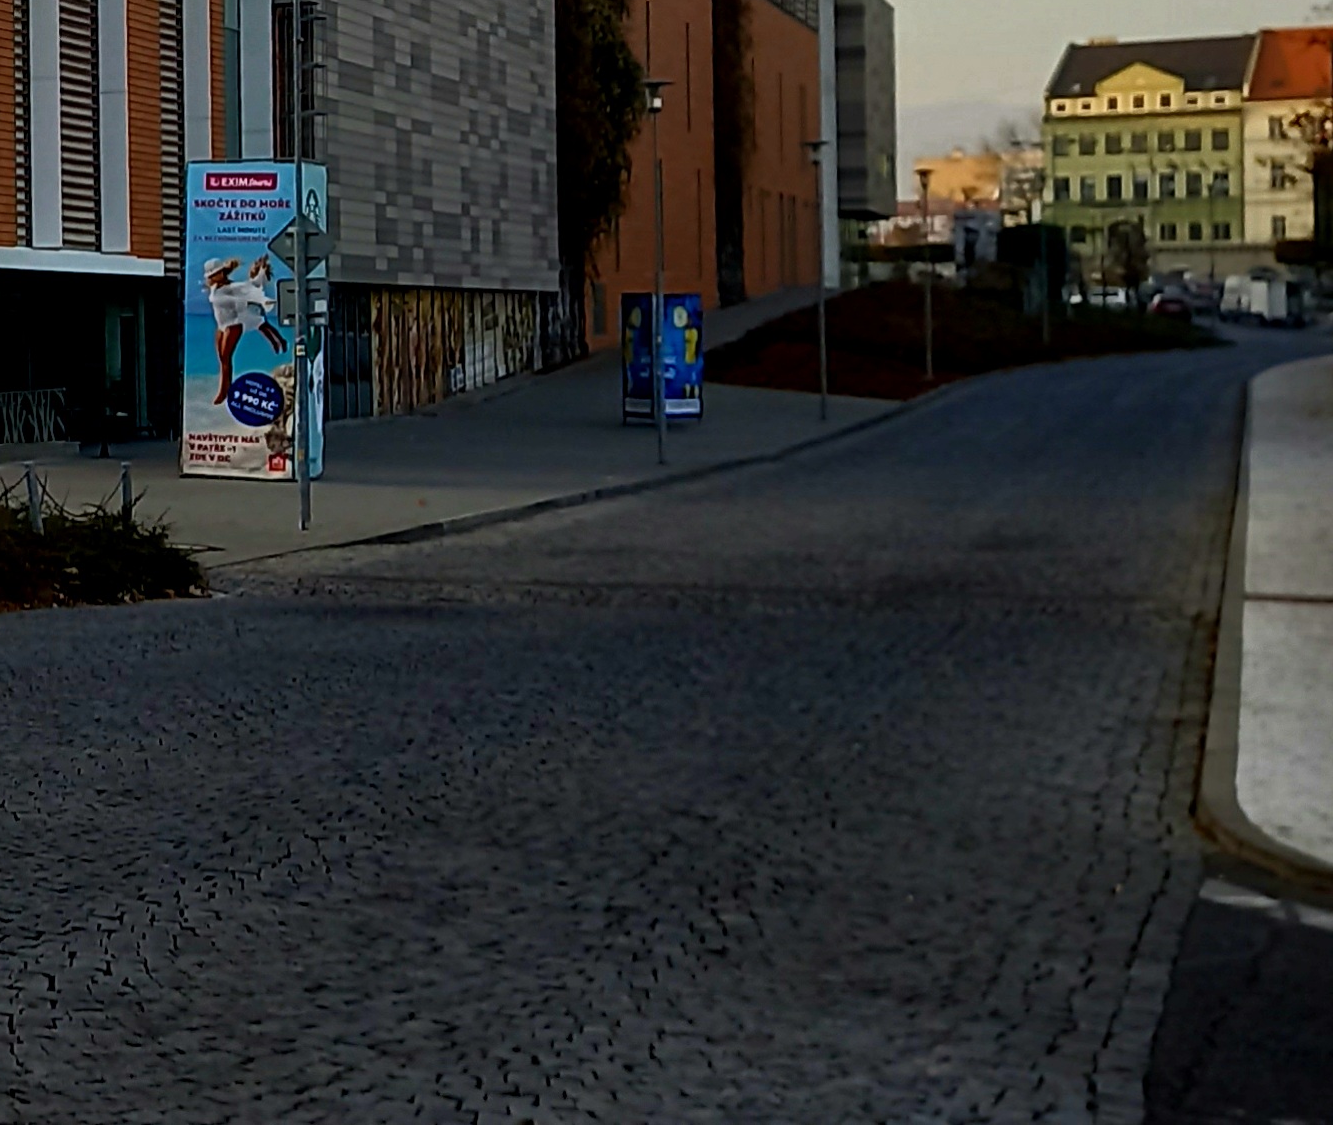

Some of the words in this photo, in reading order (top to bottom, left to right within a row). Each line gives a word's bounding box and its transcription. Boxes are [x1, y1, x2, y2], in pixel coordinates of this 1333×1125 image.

[194, 197, 237, 208] SKOČTE
[240, 199, 257, 208] DO
[259, 197, 291, 208] MOŘE
[219, 210, 266, 221] ZÁŽITKŮ
